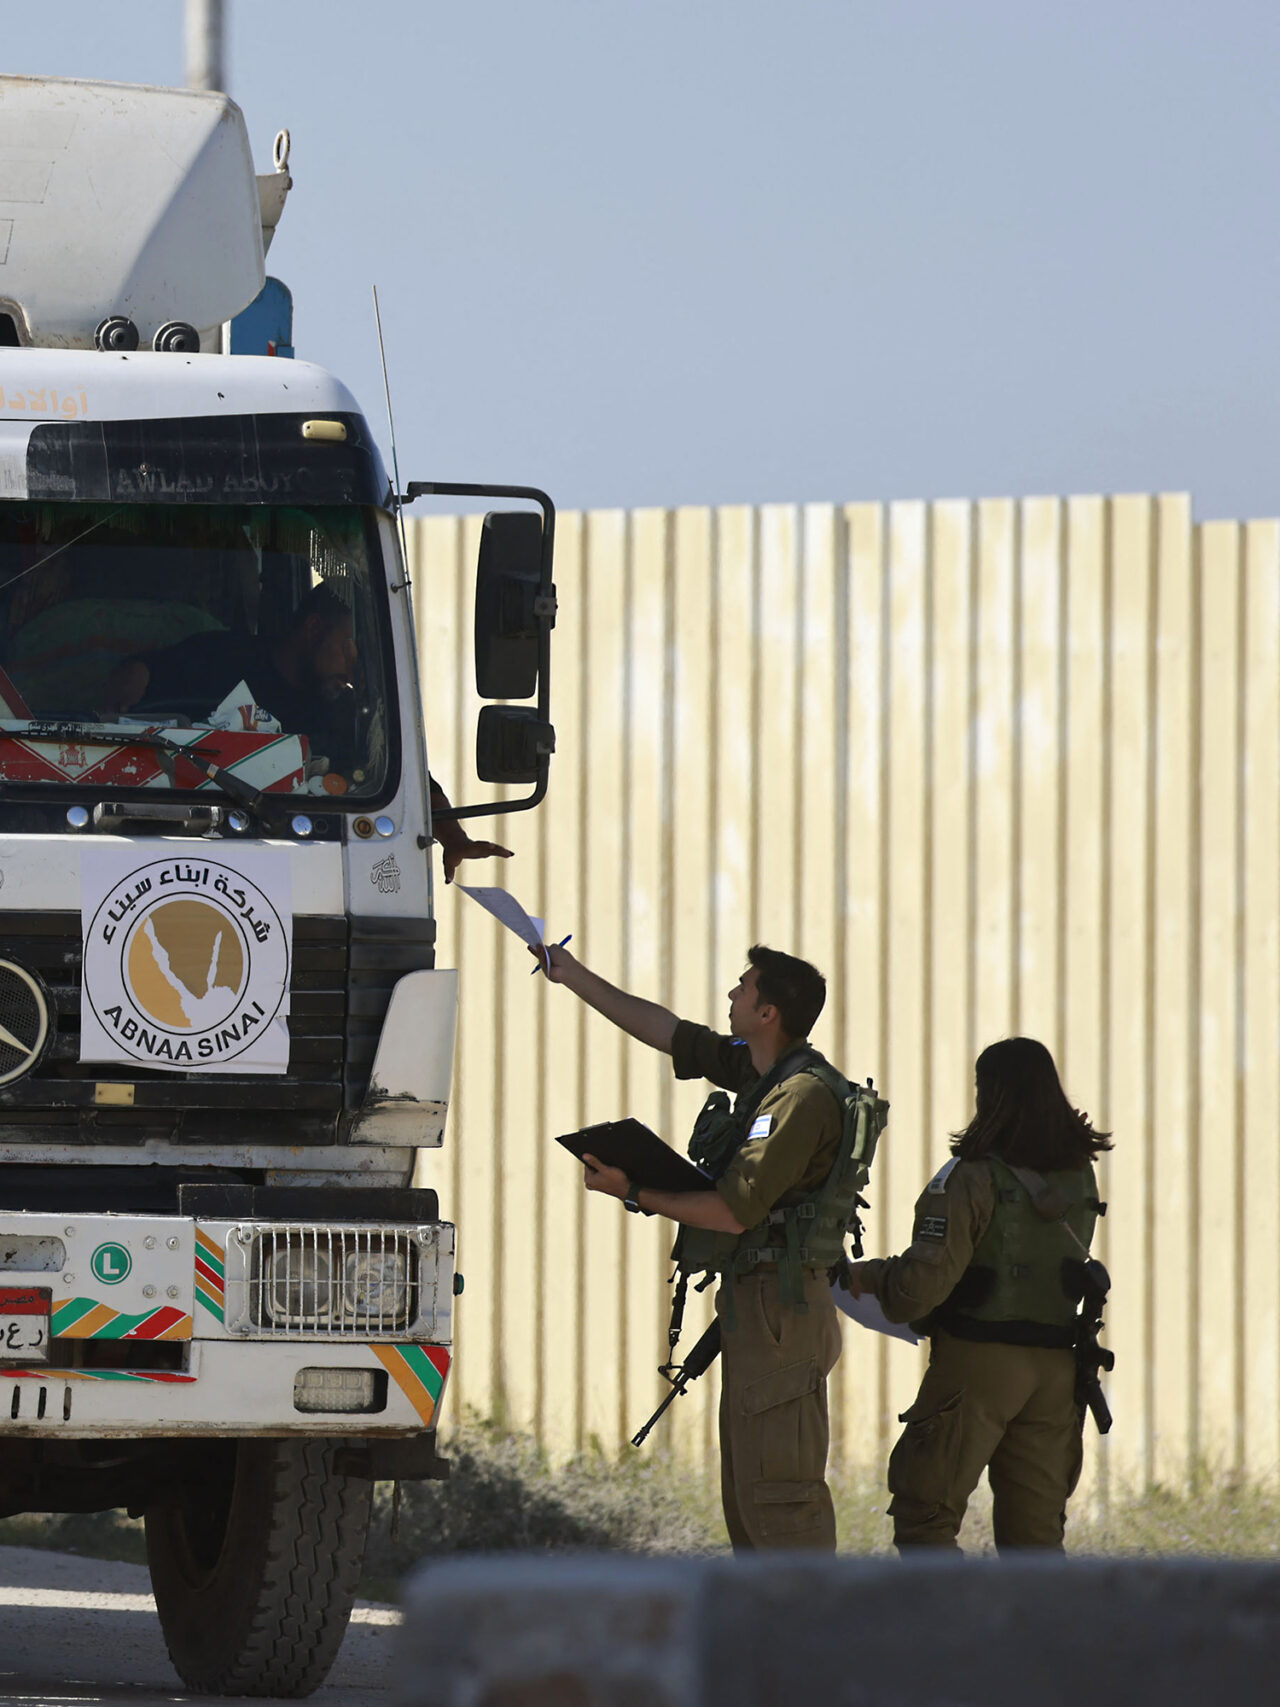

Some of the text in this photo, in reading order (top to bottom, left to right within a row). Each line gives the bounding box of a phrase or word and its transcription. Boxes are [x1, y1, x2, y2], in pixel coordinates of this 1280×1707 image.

[102, 863, 271, 945] شركة ابناء سيناء
[102, 1000, 267, 1061] ABNAA SINAI
[101, 1252, 121, 1276] L
